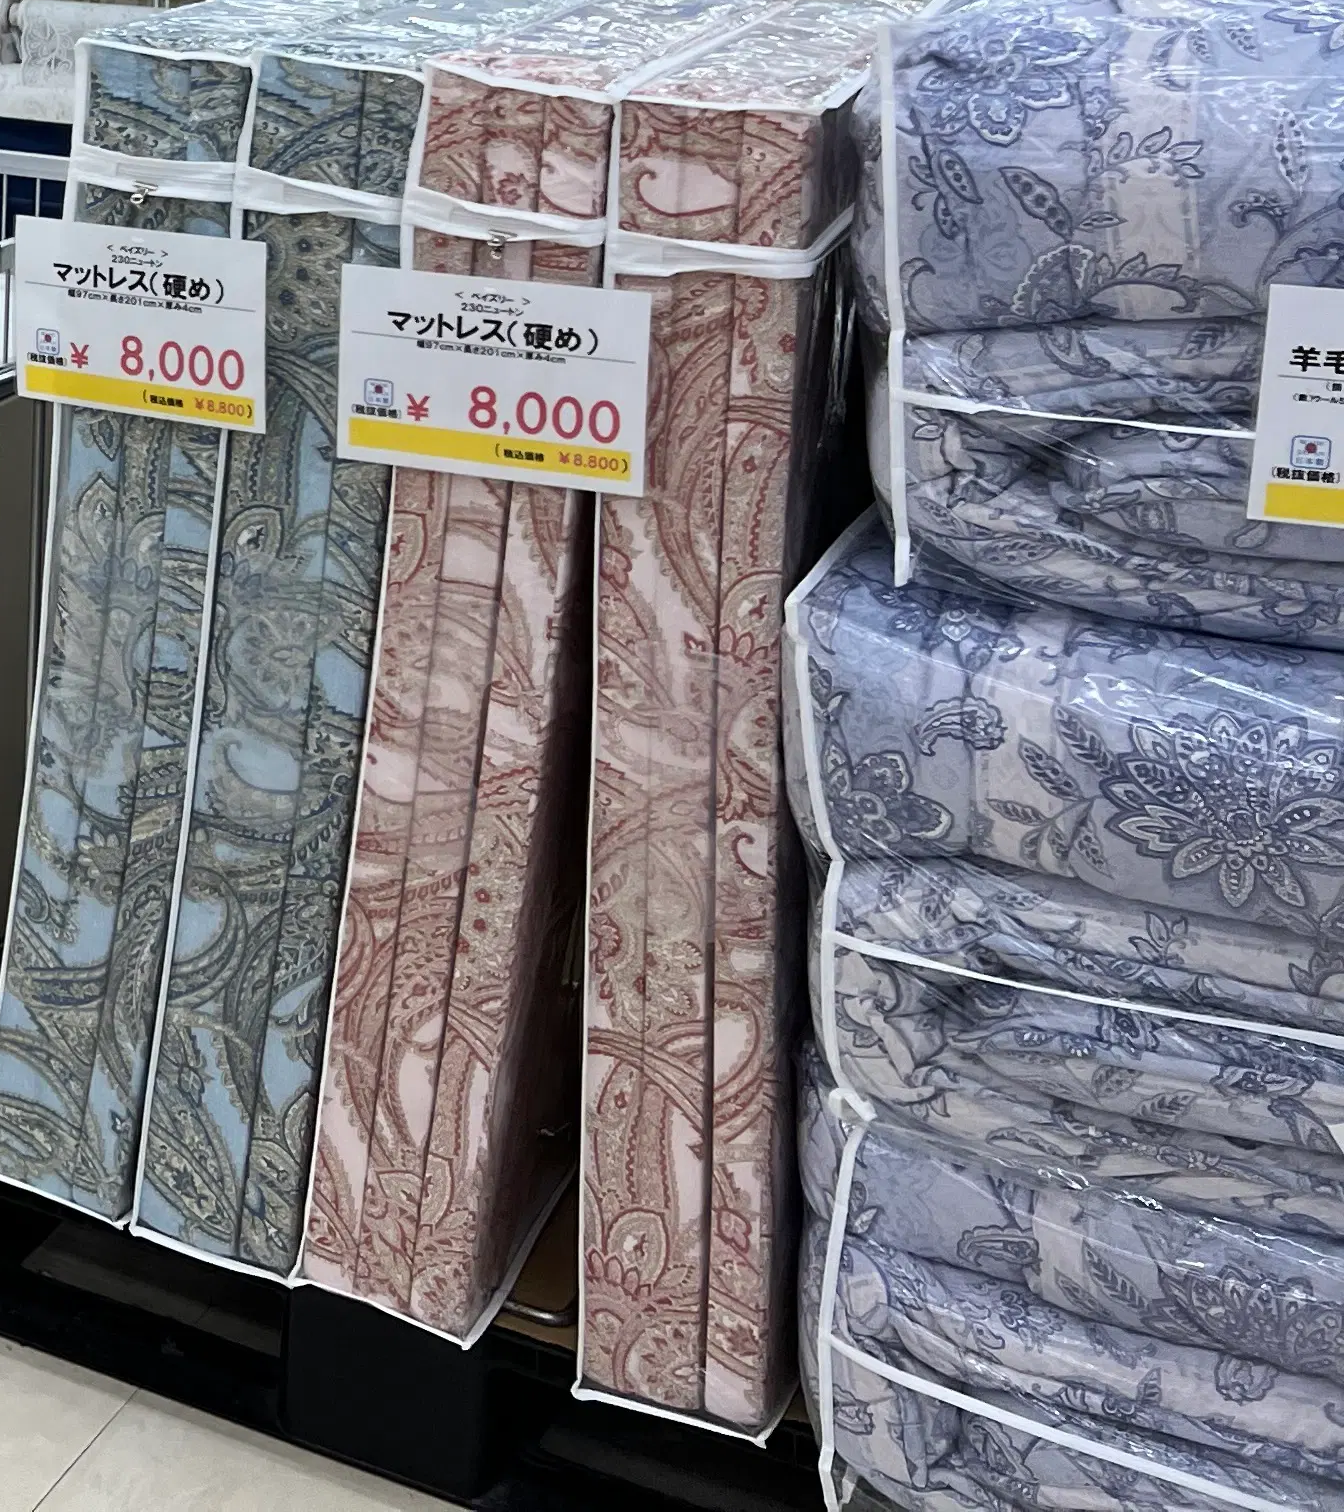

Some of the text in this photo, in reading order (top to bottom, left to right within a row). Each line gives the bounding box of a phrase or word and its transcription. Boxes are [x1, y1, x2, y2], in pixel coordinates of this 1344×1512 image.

[111, 254, 164, 268] 230ニュートン
[460, 302, 525, 317] 230ニュートン
[120, 335, 245, 391] 8,000
[468, 385, 622, 444] 8,000
